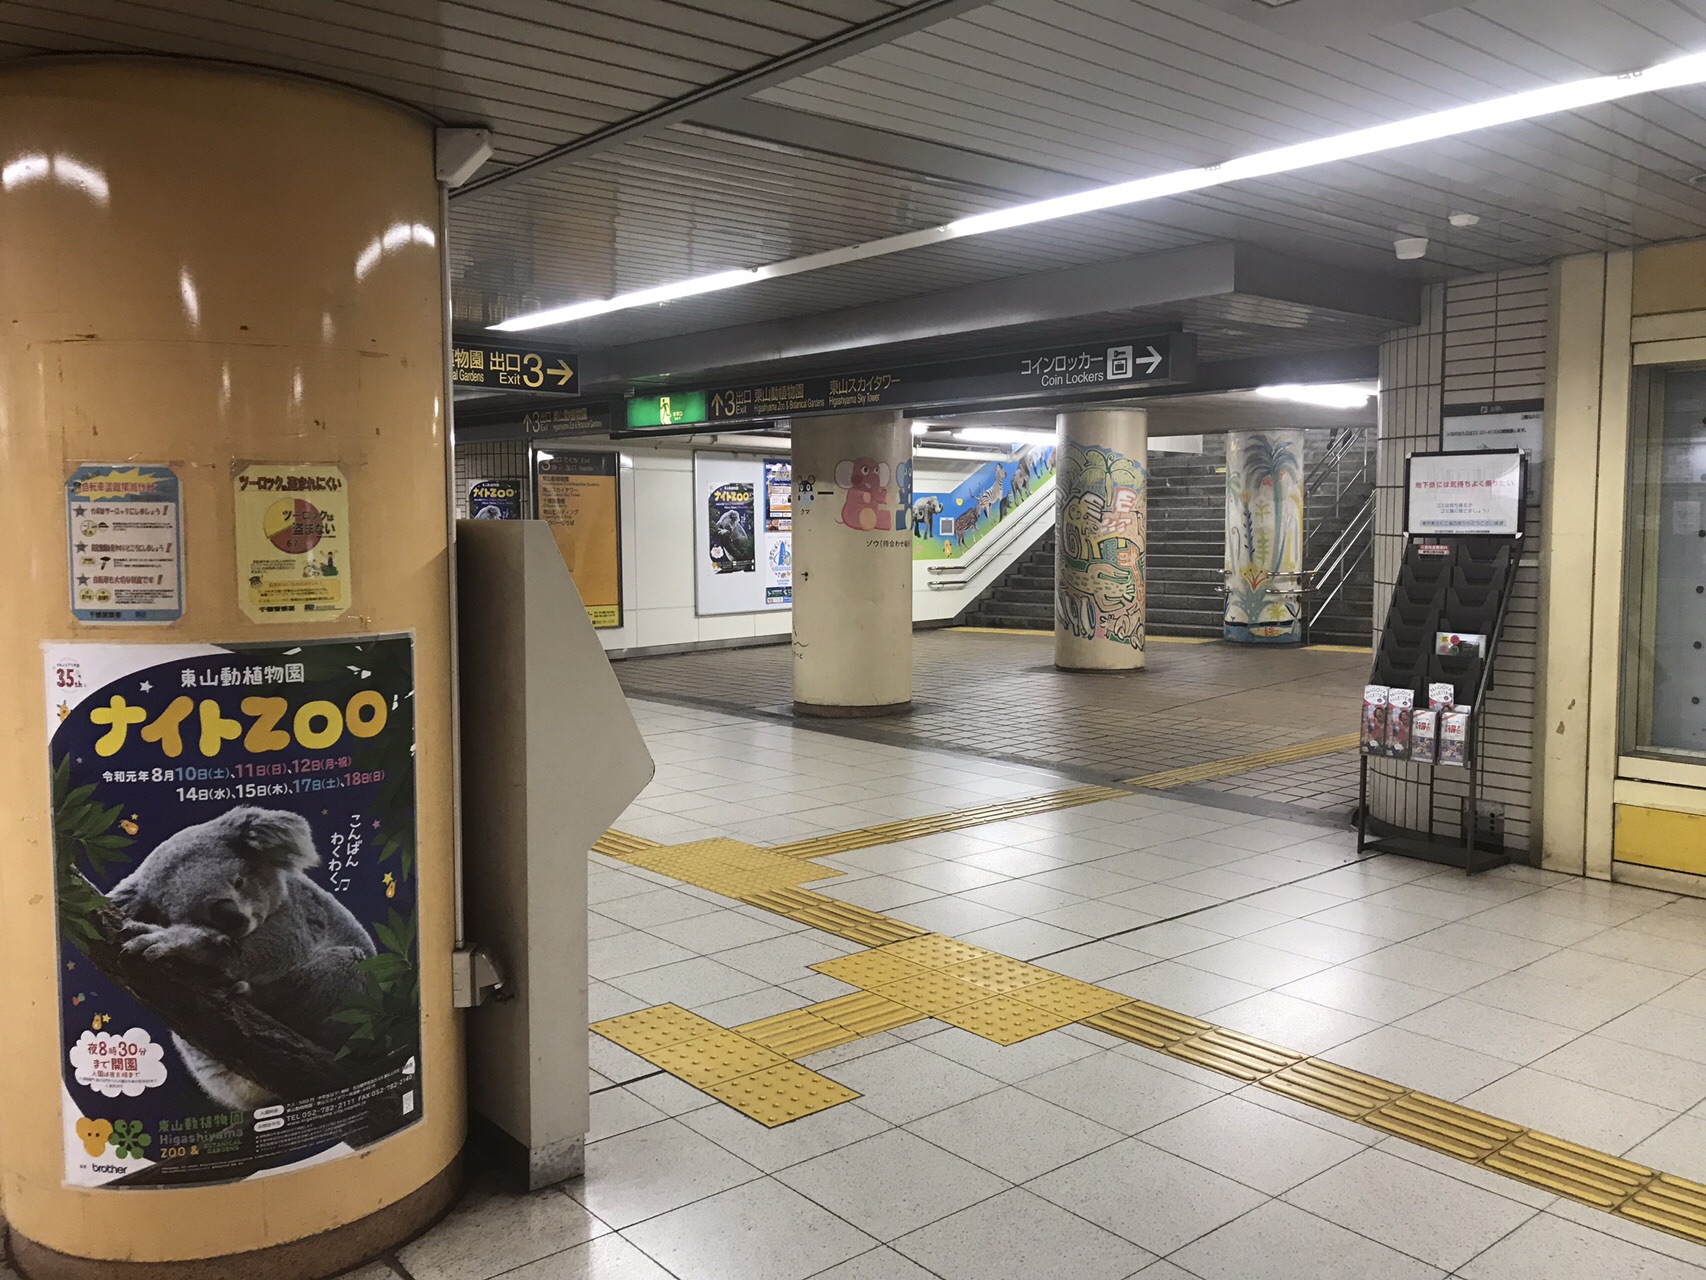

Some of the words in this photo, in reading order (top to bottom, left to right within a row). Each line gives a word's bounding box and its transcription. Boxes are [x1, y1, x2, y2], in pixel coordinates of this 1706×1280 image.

[489, 351, 521, 372] 出口
[522, 353, 544, 388] 3
[1021, 352, 1103, 375] コインロッカー
[459, 369, 485, 383] Gardens
[499, 372, 521, 385] Exit
[1041, 374, 1063, 387] Coin
[1066, 371, 1104, 385] Lockers
[724, 390, 736, 416] 3
[736, 390, 751, 405] 出口
[754, 383, 804, 402] 東山動植物園
[829, 374, 901, 395] 東山スカイタワー
[829, 395, 856, 407] Higashiyama
[857, 393, 866, 405] Sky
[866, 392, 880, 402] Tower
[736, 404, 747, 415] Exit
[532, 411, 540, 433] 3
[1415, 480, 1514, 489] 地下鉄には気持ちよく乗りたい
[283, 510, 335, 521] ツーロックは
[293, 522, 336, 535] 盗まない
[180, 663, 305, 688] 東山動植物園
[345, 814, 363, 867] こんばん
[87, 1041, 147, 1057] 夜8時30分
[93, 1058, 138, 1071] まで開園
[286, 1114, 301, 1122] TEL
[358, 1092, 371, 1102] FAX
[158, 1111, 244, 1133] 東山動植物園
[159, 1127, 244, 1147] Higashiyama
[160, 1147, 186, 1159] ZOO
[190, 1144, 199, 1155] &
[91, 1162, 128, 1175] brother
